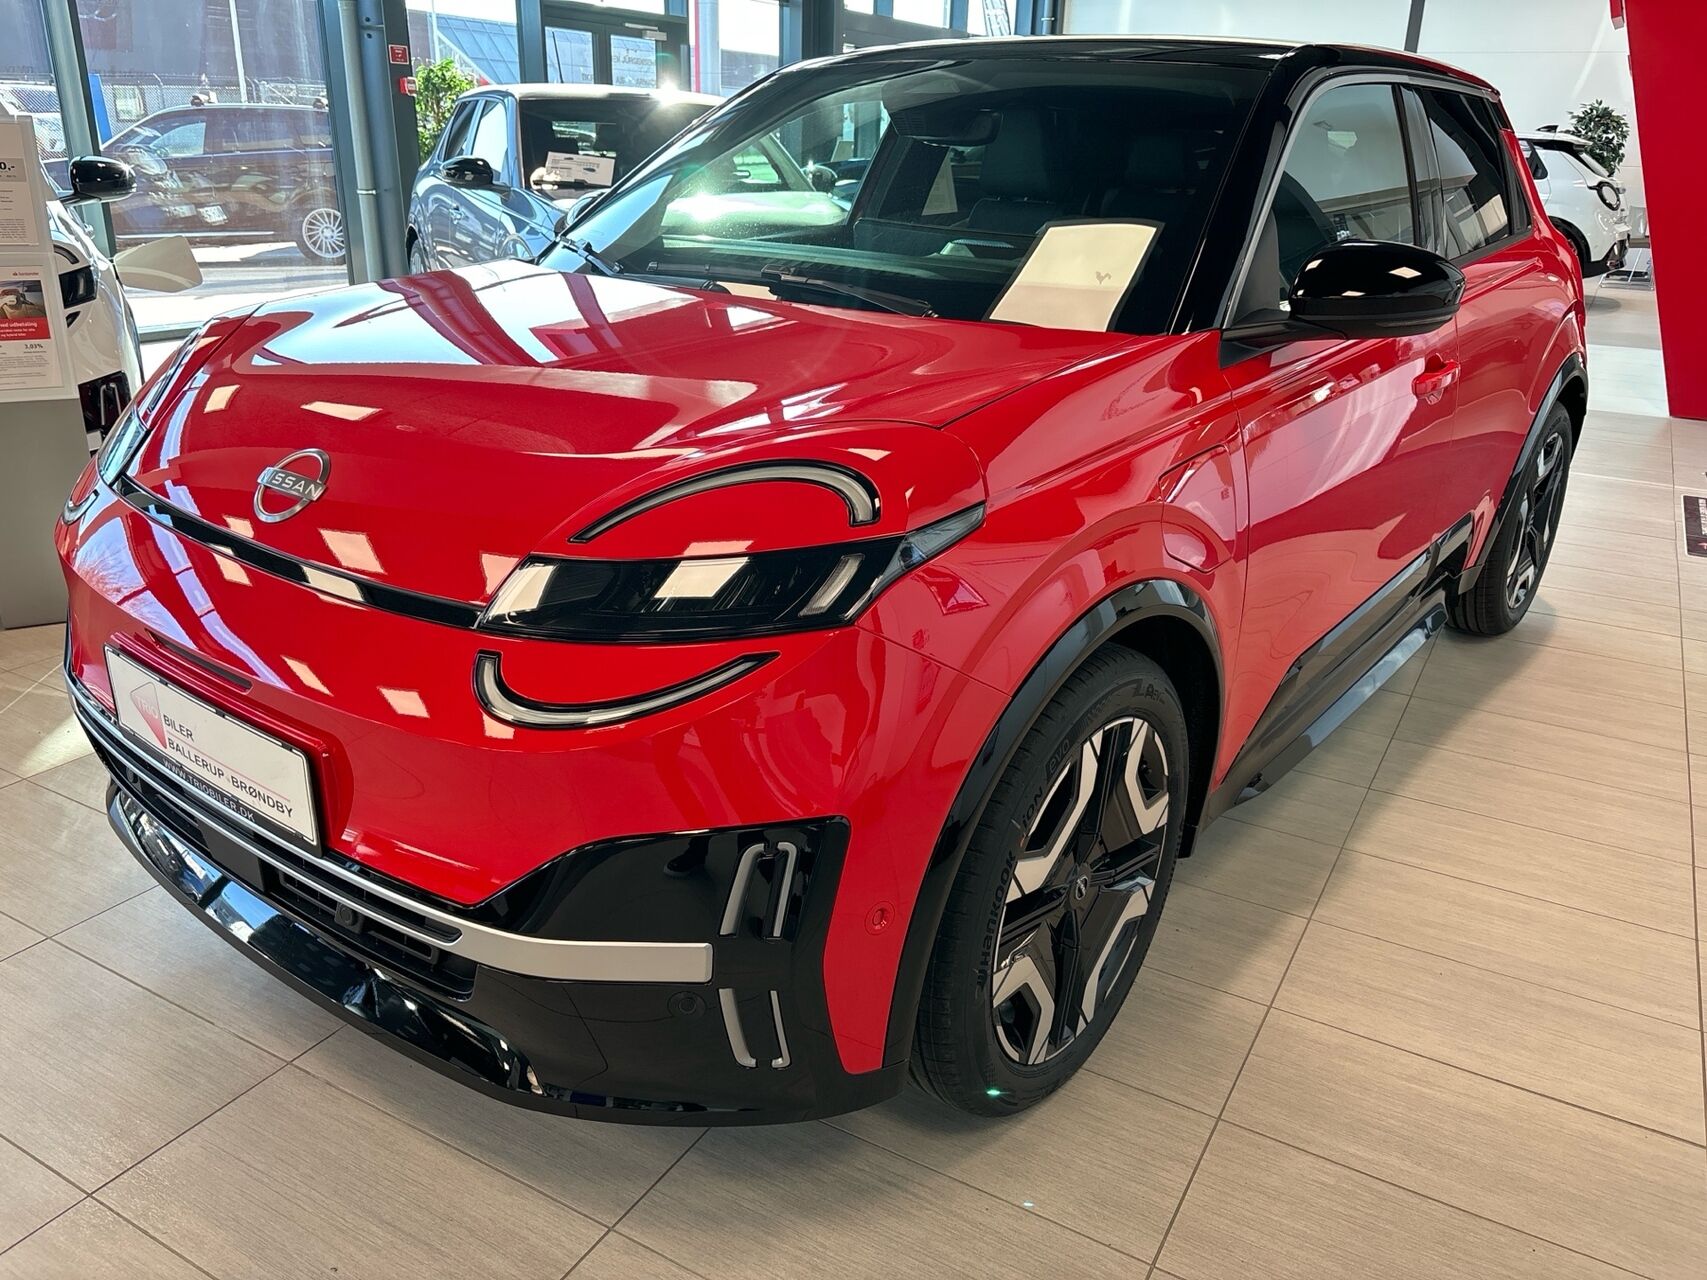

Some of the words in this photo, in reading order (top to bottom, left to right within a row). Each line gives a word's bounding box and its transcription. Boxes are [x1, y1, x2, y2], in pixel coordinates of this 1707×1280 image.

[261, 468, 322, 498] NISSAN
[163, 714, 195, 742] BILER
[163, 758, 255, 822] WWW.TRIOBILER.DK
[167, 737, 225, 779] BALLERUP
[230, 775, 293, 818] BRØNDBY
